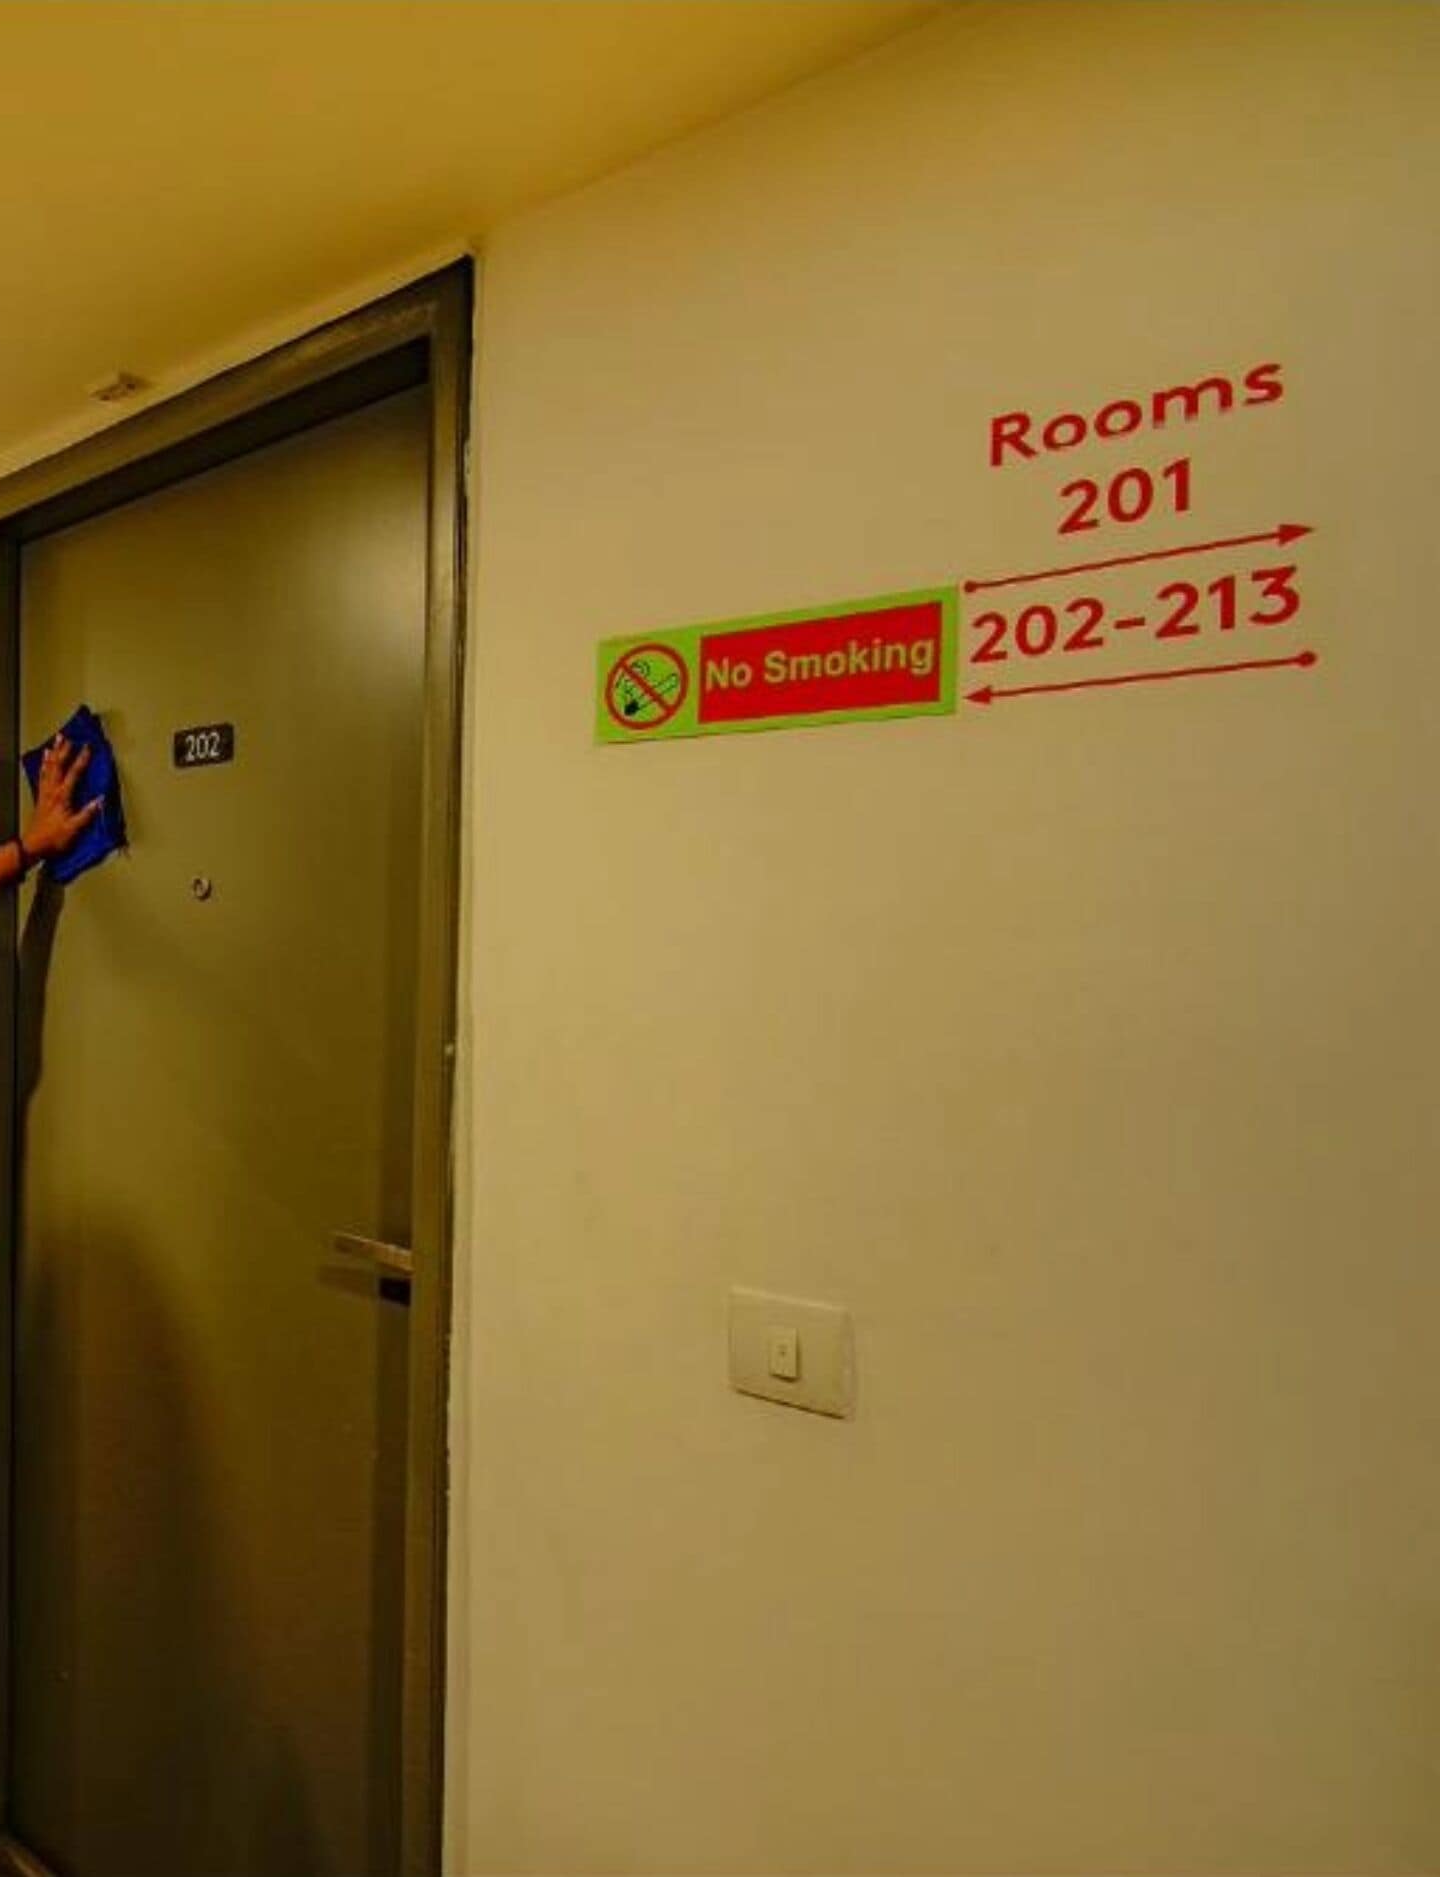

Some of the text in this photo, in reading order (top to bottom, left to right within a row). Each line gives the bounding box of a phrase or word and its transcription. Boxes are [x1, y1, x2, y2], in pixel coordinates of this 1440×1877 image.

[989, 361, 1285, 467] Rooms
[1057, 457, 1192, 535] 201
[969, 564, 1301, 663] 202-213
[705, 634, 935, 692] No Smoking
[185, 732, 221, 761] 202
